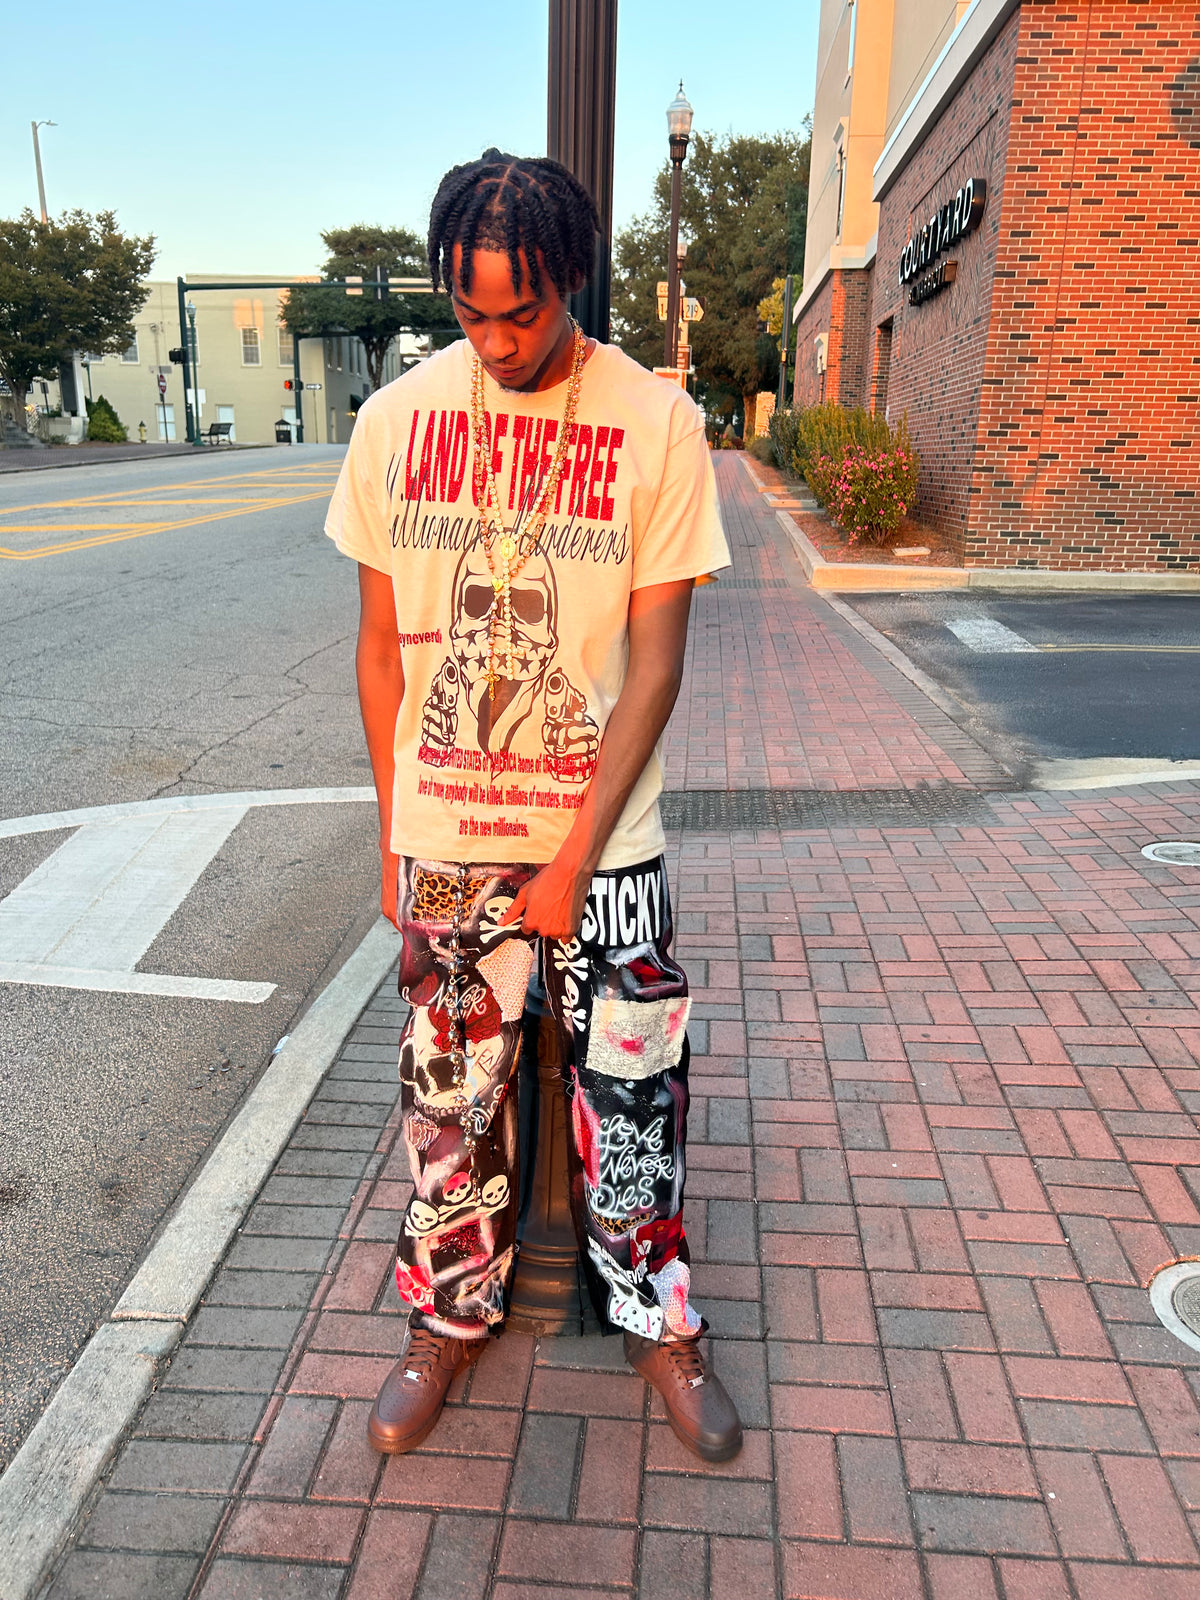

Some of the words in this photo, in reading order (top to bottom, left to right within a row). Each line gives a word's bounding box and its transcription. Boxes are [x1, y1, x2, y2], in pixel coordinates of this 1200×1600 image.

[899, 177, 975, 285] COURTYARD
[404, 409, 469, 503] LAND
[471, 411, 509, 507] OF
[508, 414, 559, 515] THE
[553, 423, 625, 522] FREE
[444, 780, 469, 806] anybody
[479, 783, 486, 804] be
[528, 785, 536, 807] of
[458, 819, 469, 836] are
[468, 815, 479, 836] the
[581, 869, 661, 946] STICKY
